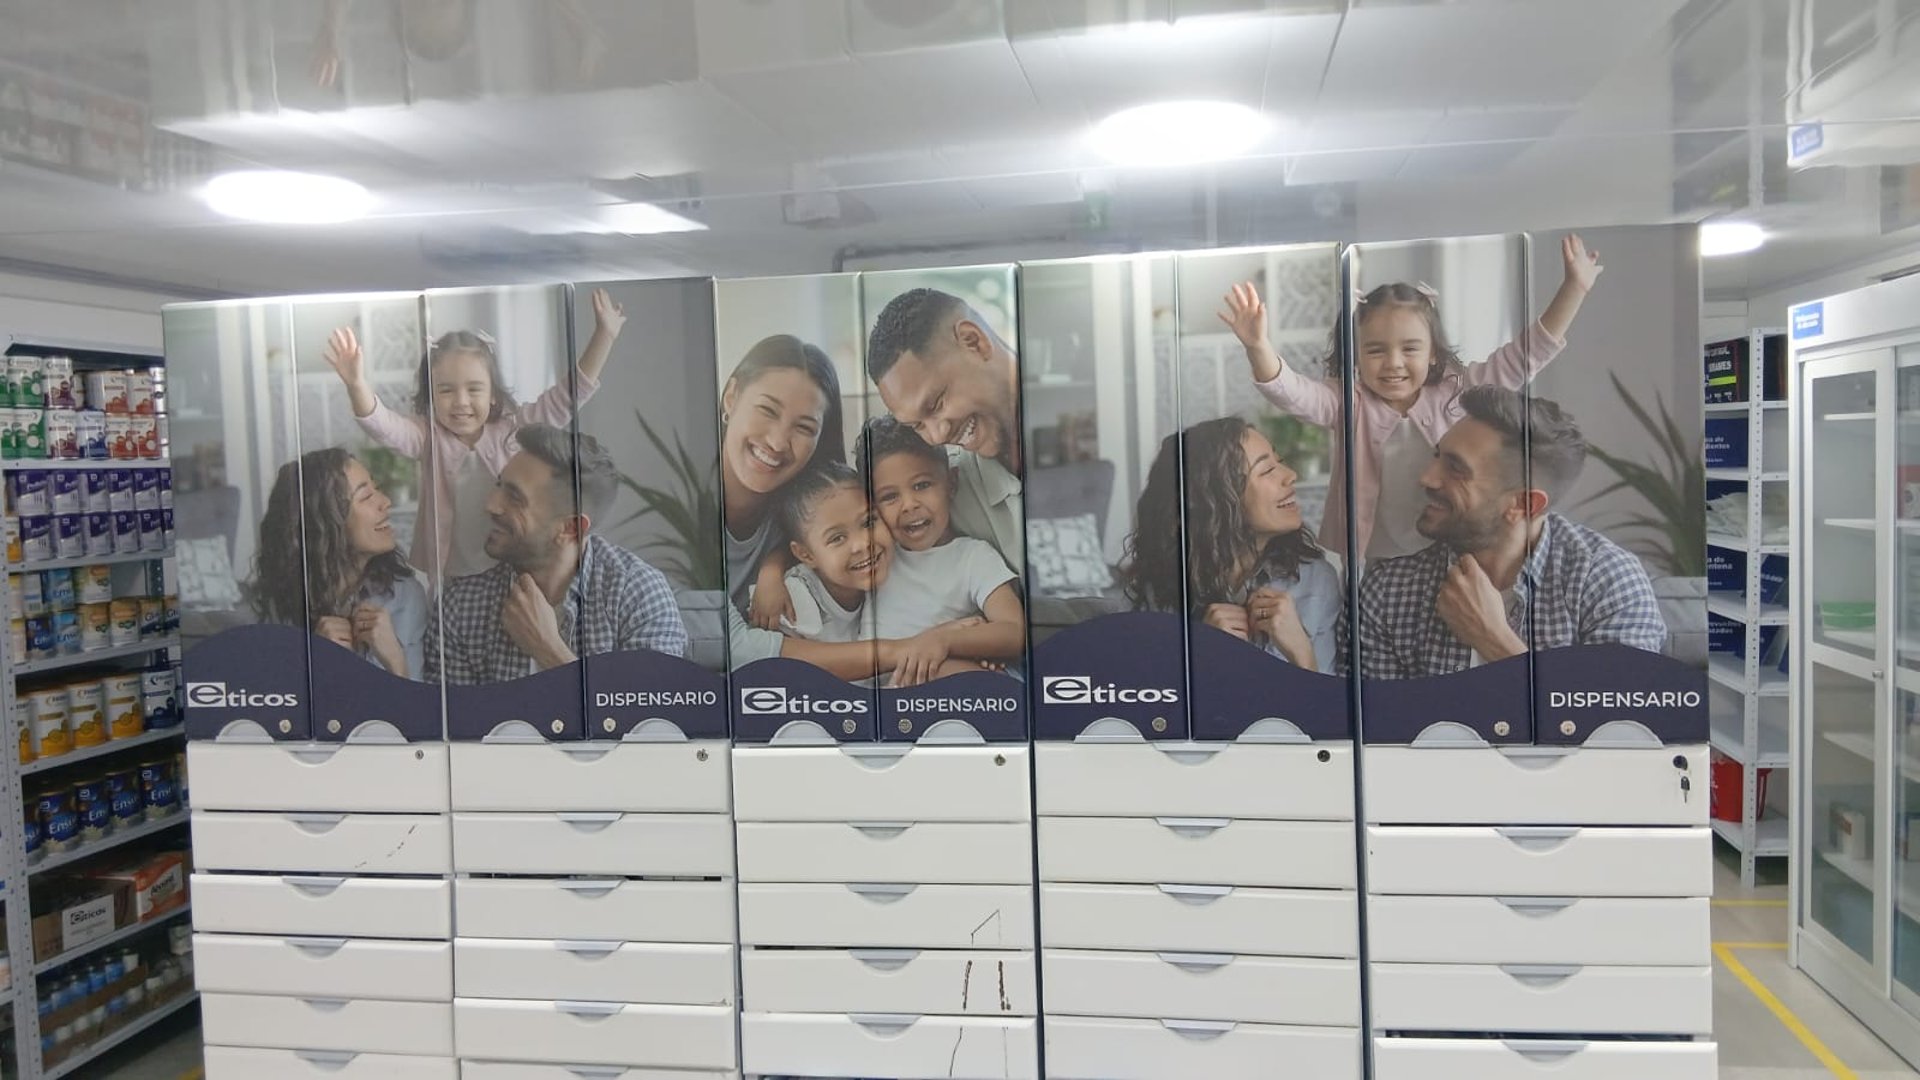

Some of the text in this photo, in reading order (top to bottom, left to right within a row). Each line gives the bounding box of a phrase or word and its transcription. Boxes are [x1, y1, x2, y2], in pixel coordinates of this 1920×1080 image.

[187, 682, 298, 708] eticos
[595, 691, 717, 707] DISPENSARIO
[1043, 676, 1178, 704] eticos
[1550, 691, 1700, 708] DISPENSARIO
[741, 687, 868, 715] eticos
[896, 698, 1018, 713] DISPENSARIO
